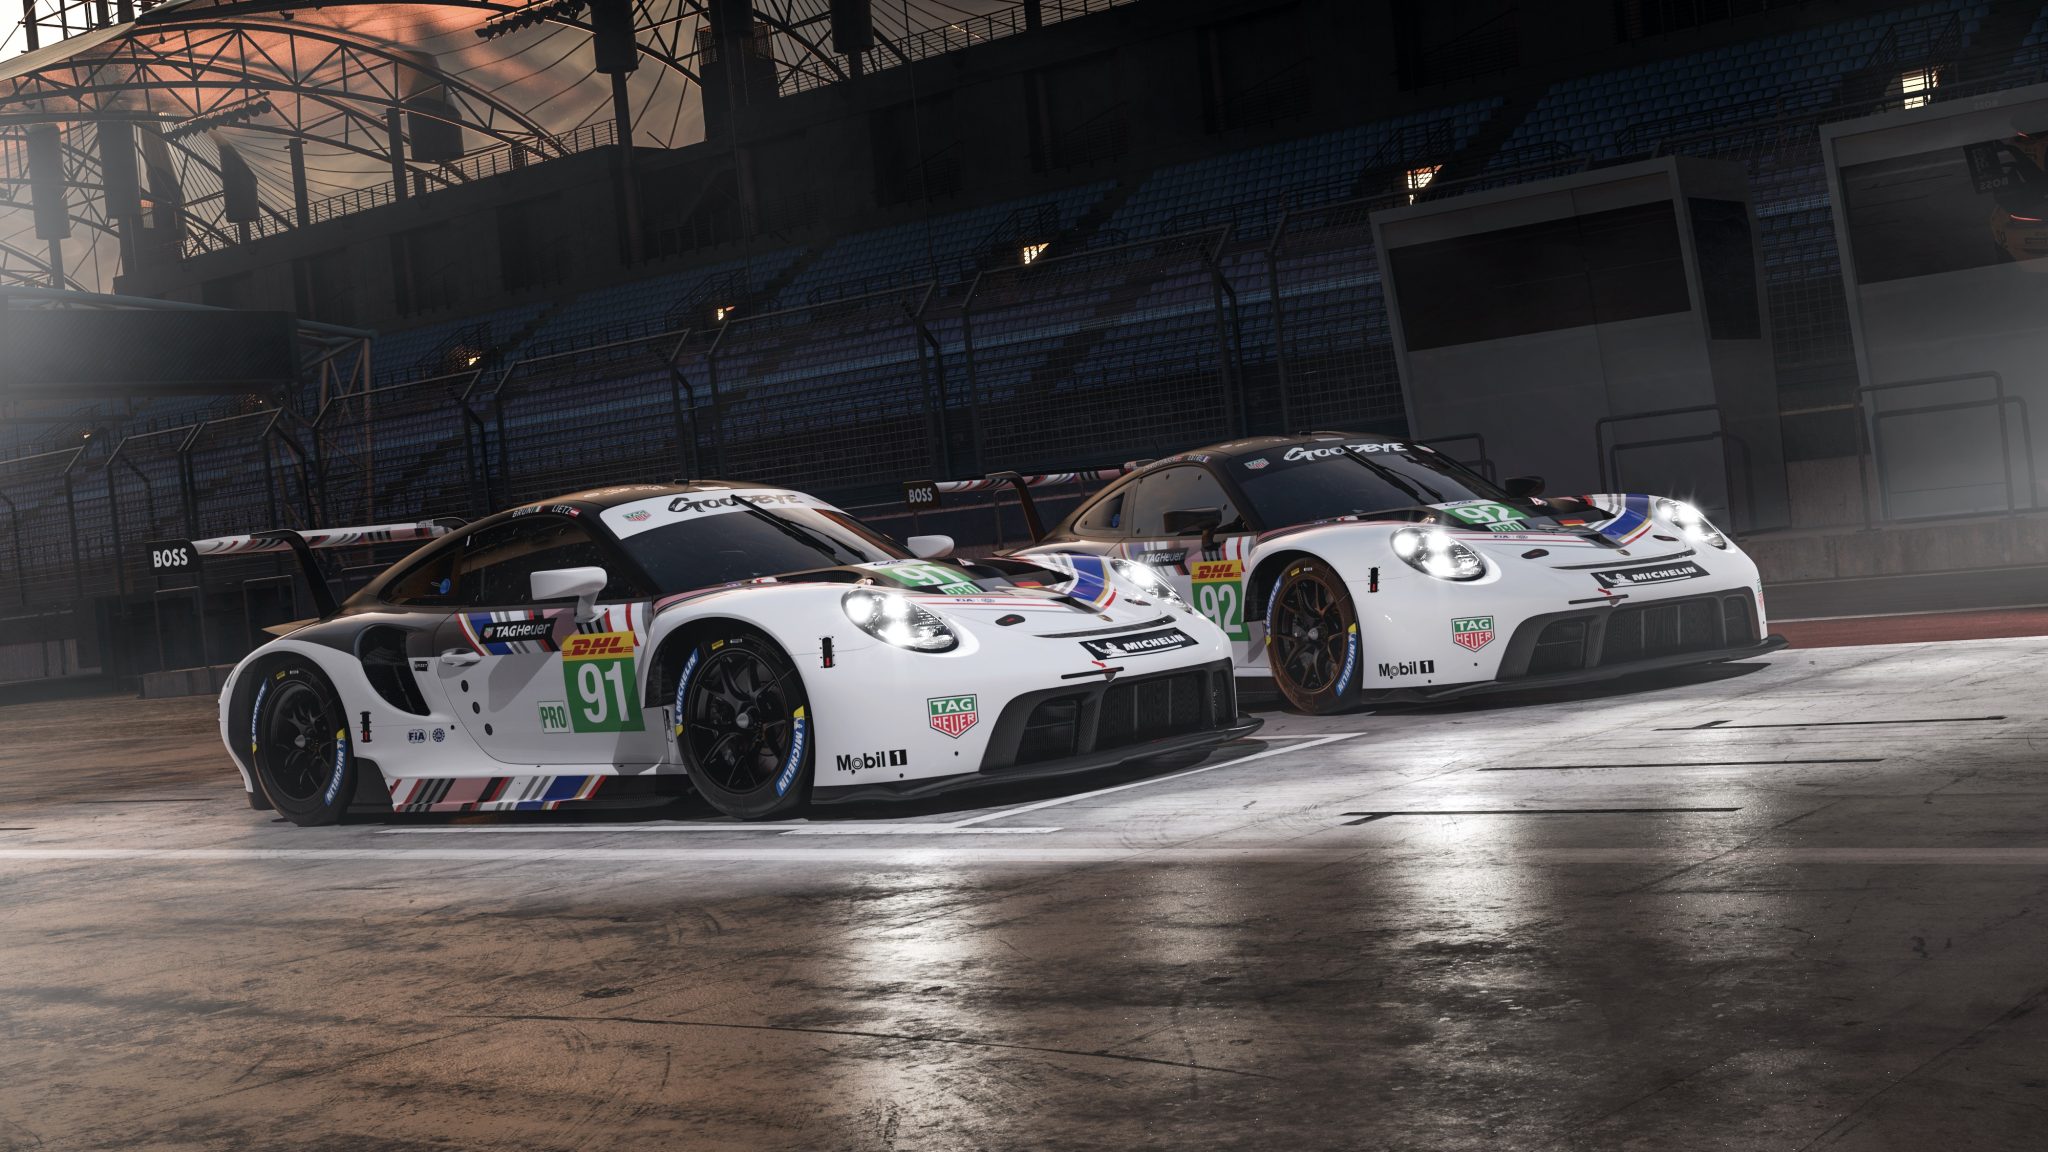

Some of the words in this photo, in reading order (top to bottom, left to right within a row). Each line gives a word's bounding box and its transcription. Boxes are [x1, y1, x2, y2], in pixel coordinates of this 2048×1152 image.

[908, 487, 933, 503] BOSS
[551, 505, 573, 514] LIETZ
[1455, 505, 1525, 524] 92
[153, 547, 188, 568] BOSS
[891, 565, 966, 586] 91
[1198, 564, 1234, 579] DHL
[1632, 566, 1697, 582] MICHELIN
[1200, 584, 1243, 633] 92
[1456, 619, 1490, 631] TAG
[571, 637, 624, 656] DHL
[1123, 634, 1186, 651] MICHELIN
[1456, 631, 1492, 649] HEUER
[1337, 643, 1355, 692] MICHELIN
[1378, 661, 1417, 677] Mobil
[578, 661, 630, 723] 91
[676, 655, 697, 713] MICHELIN
[933, 698, 973, 713] TAG
[540, 705, 567, 729] PRO
[933, 713, 975, 733] HEUER
[408, 732, 425, 741] FIA
[778, 730, 803, 791] MICHELIN
[836, 751, 886, 771] Mobil
[325, 749, 345, 802] MICHELIN
